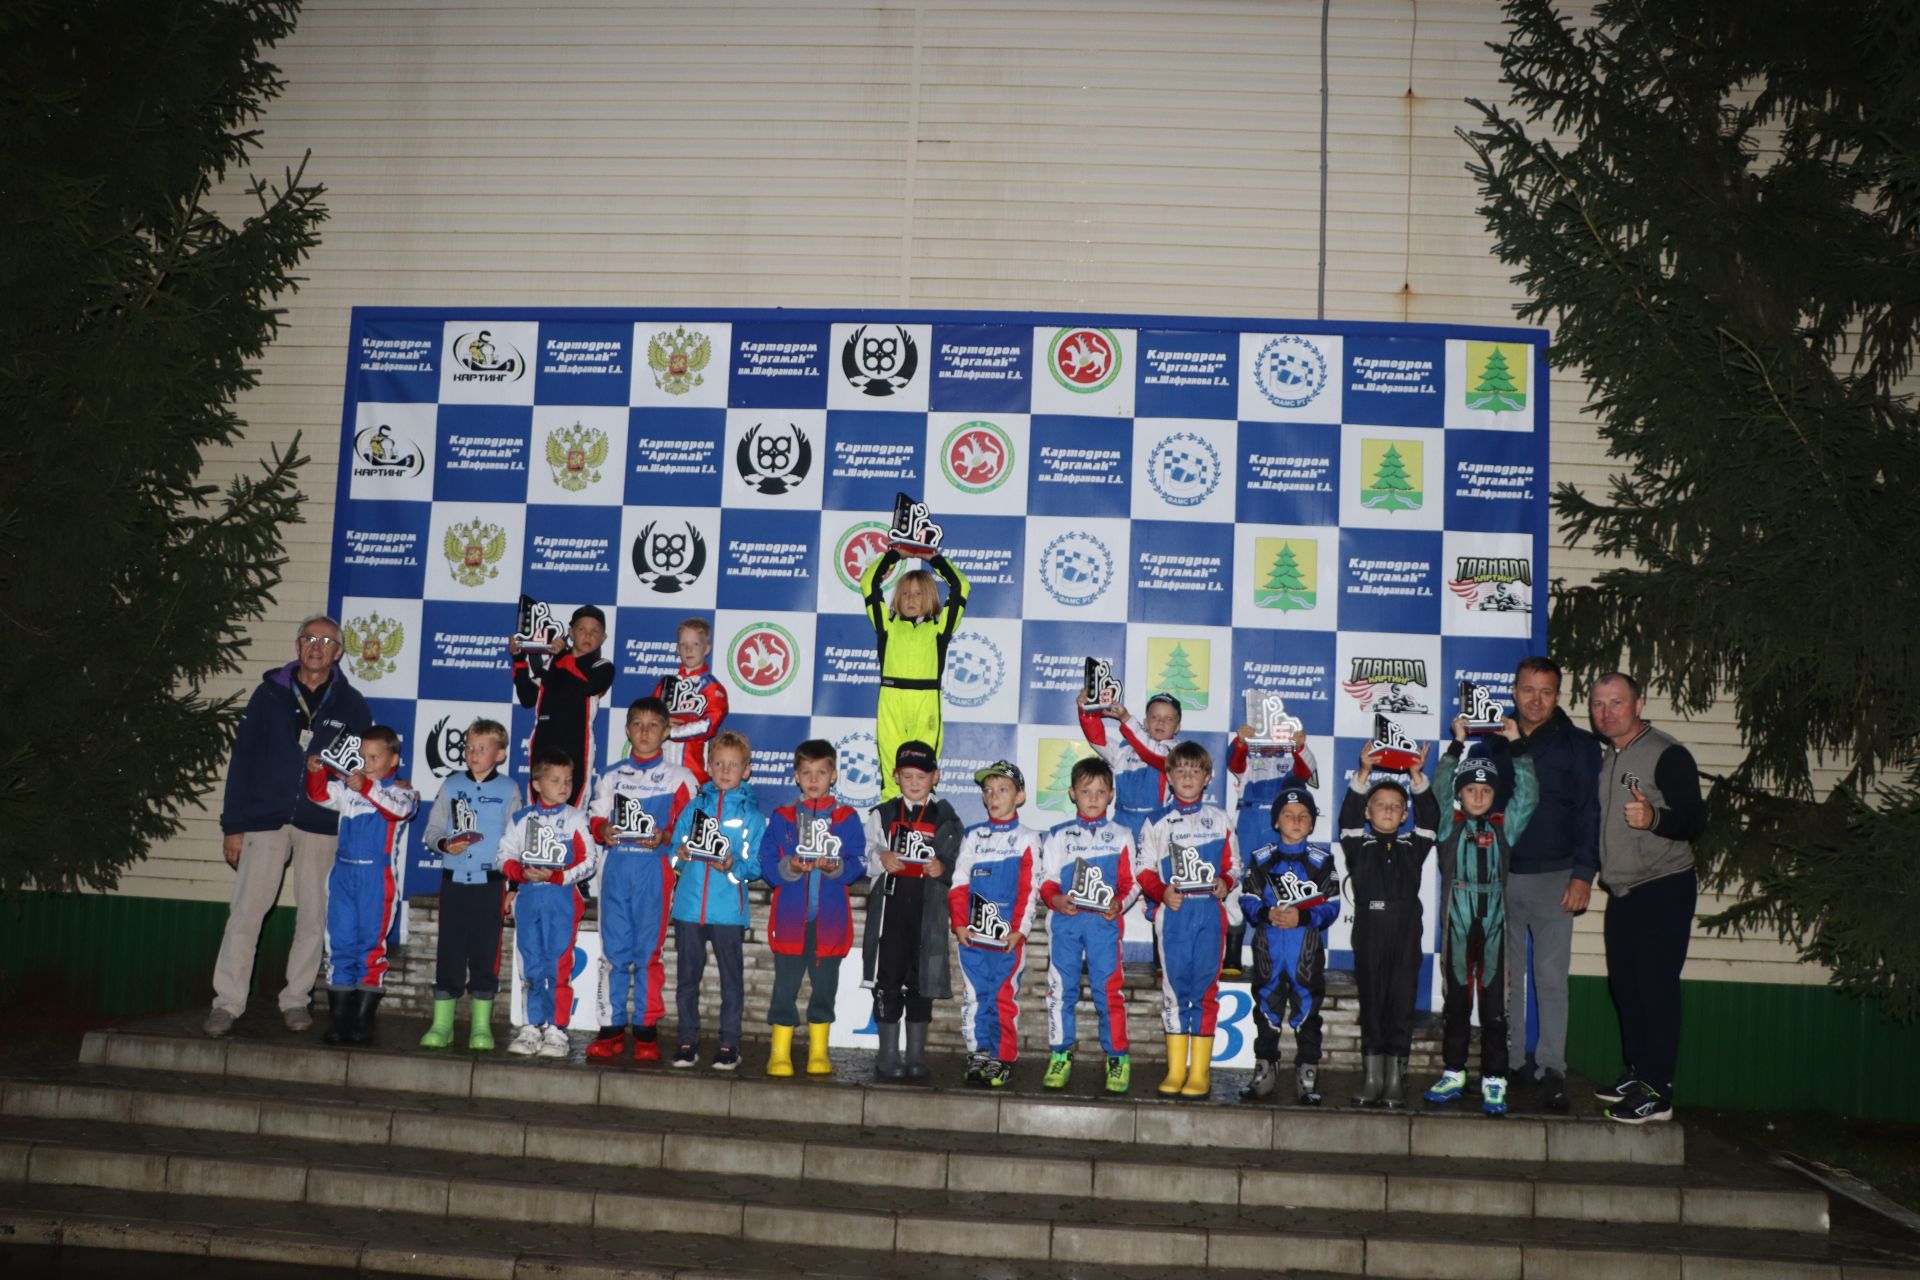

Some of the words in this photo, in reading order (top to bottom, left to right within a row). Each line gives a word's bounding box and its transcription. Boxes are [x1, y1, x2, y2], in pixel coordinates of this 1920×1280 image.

[362, 338, 431, 349] Картодром
[547, 340, 620, 351] Картодром
[741, 342, 817, 353] Картодром
[942, 344, 1020, 356] Картодром
[1147, 350, 1226, 362] Картодром
[1353, 357, 1432, 370] Картодром
[450, 436, 523, 447] Картодром
[639, 439, 714, 450] Картодром
[836, 442, 913, 454] Картодром
[1041, 447, 1120, 460] Картодром
[1249, 454, 1329, 468] Картодром
[1458, 462, 1534, 475] Картодром
[346, 531, 416, 542] Картодром
[534, 536, 608, 548] Картодром
[730, 541, 806, 554] Картодром
[938, 548, 1012, 560] артодром
[1140, 553, 1220, 566] Картодром
[1349, 558, 1429, 571] Картодром
[434, 632, 509, 646] Картодром
[626, 640, 678, 652] Картод
[825, 647, 878, 659] Картод
[1244, 662, 1325, 675] Картодром
